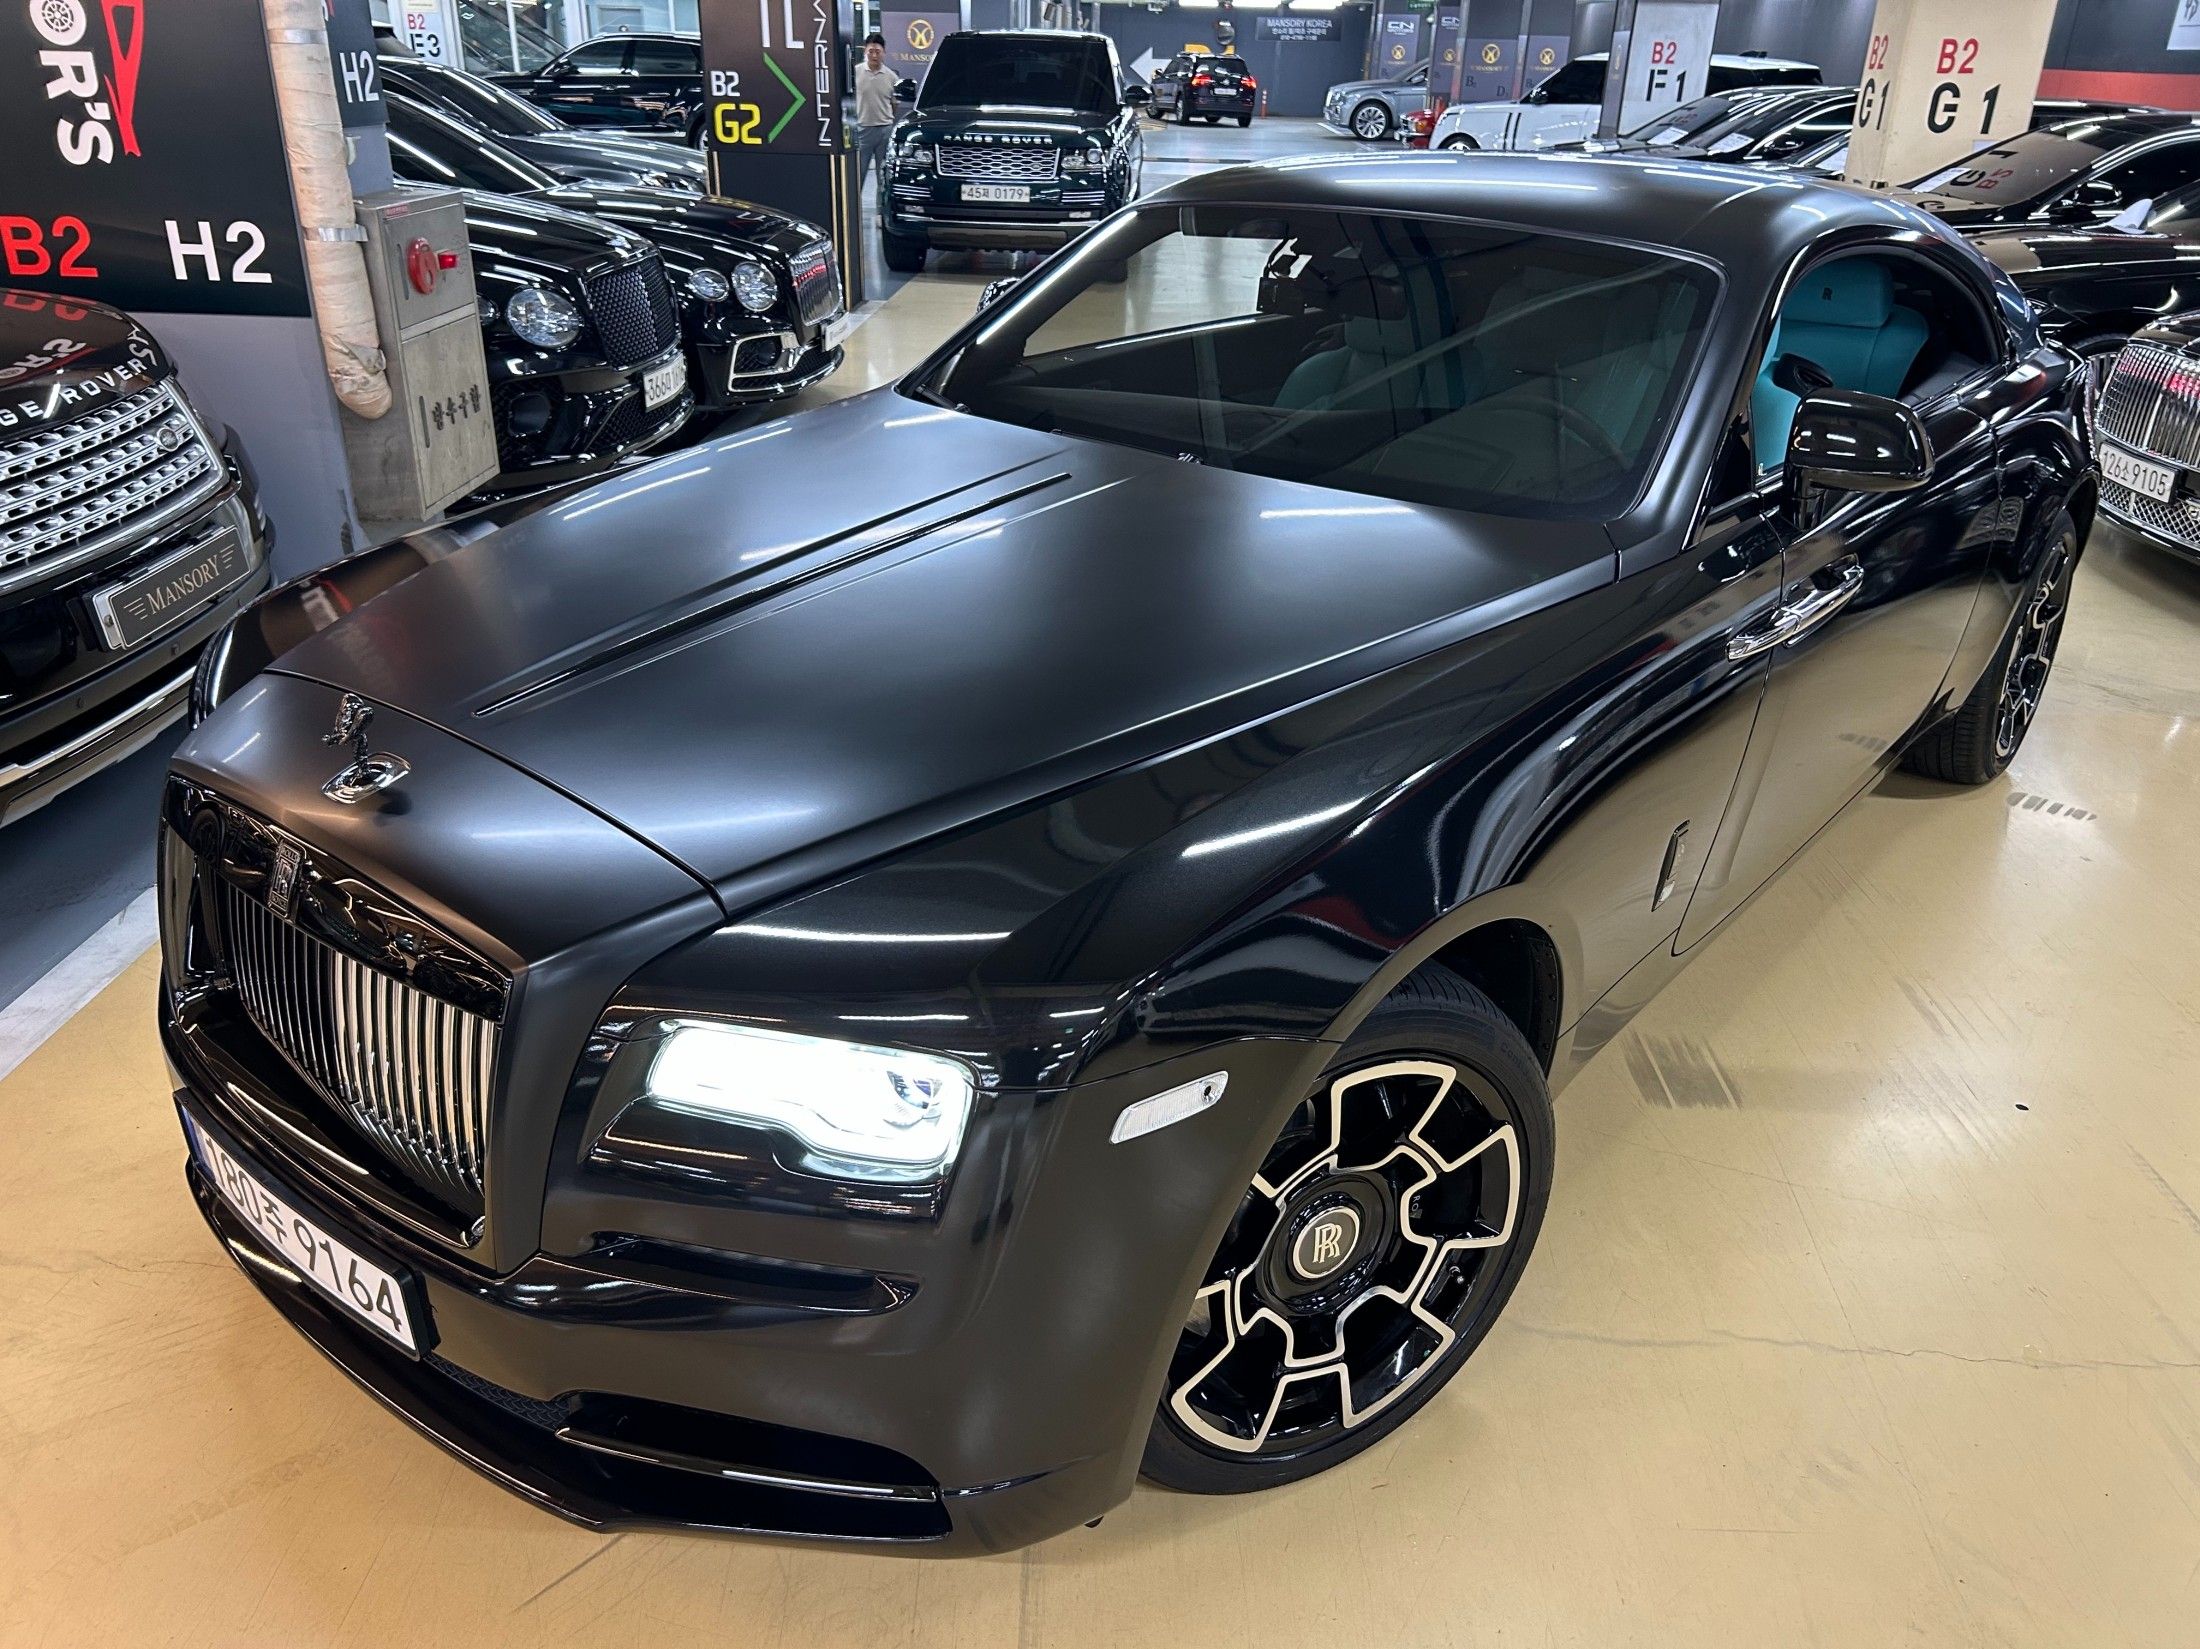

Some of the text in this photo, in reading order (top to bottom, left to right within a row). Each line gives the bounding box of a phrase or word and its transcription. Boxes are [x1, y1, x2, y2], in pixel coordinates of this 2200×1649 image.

[407, 14, 426, 30] B2
[1267, 19, 1332, 28] MANSORY KOREA
[410, 33, 441, 58] E3
[1651, 41, 1677, 64] B2
[1868, 35, 1889, 70] B2
[1936, 38, 1980, 74] B2
[339, 50, 380, 103] H2
[710, 70, 741, 97] B2
[714, 103, 763, 145] G2
[944, 135, 1053, 144] RANGE ROVER
[994, 187, 1024, 200] 0179
[0, 215, 273, 284] B2 H2
[57, 357, 149, 406] ROVER
[2132, 463, 2169, 496] 9105
[146, 554, 220, 614] MANSORY
[1312, 1222, 1343, 1264] RR
[293, 1218, 403, 1333] 9164
